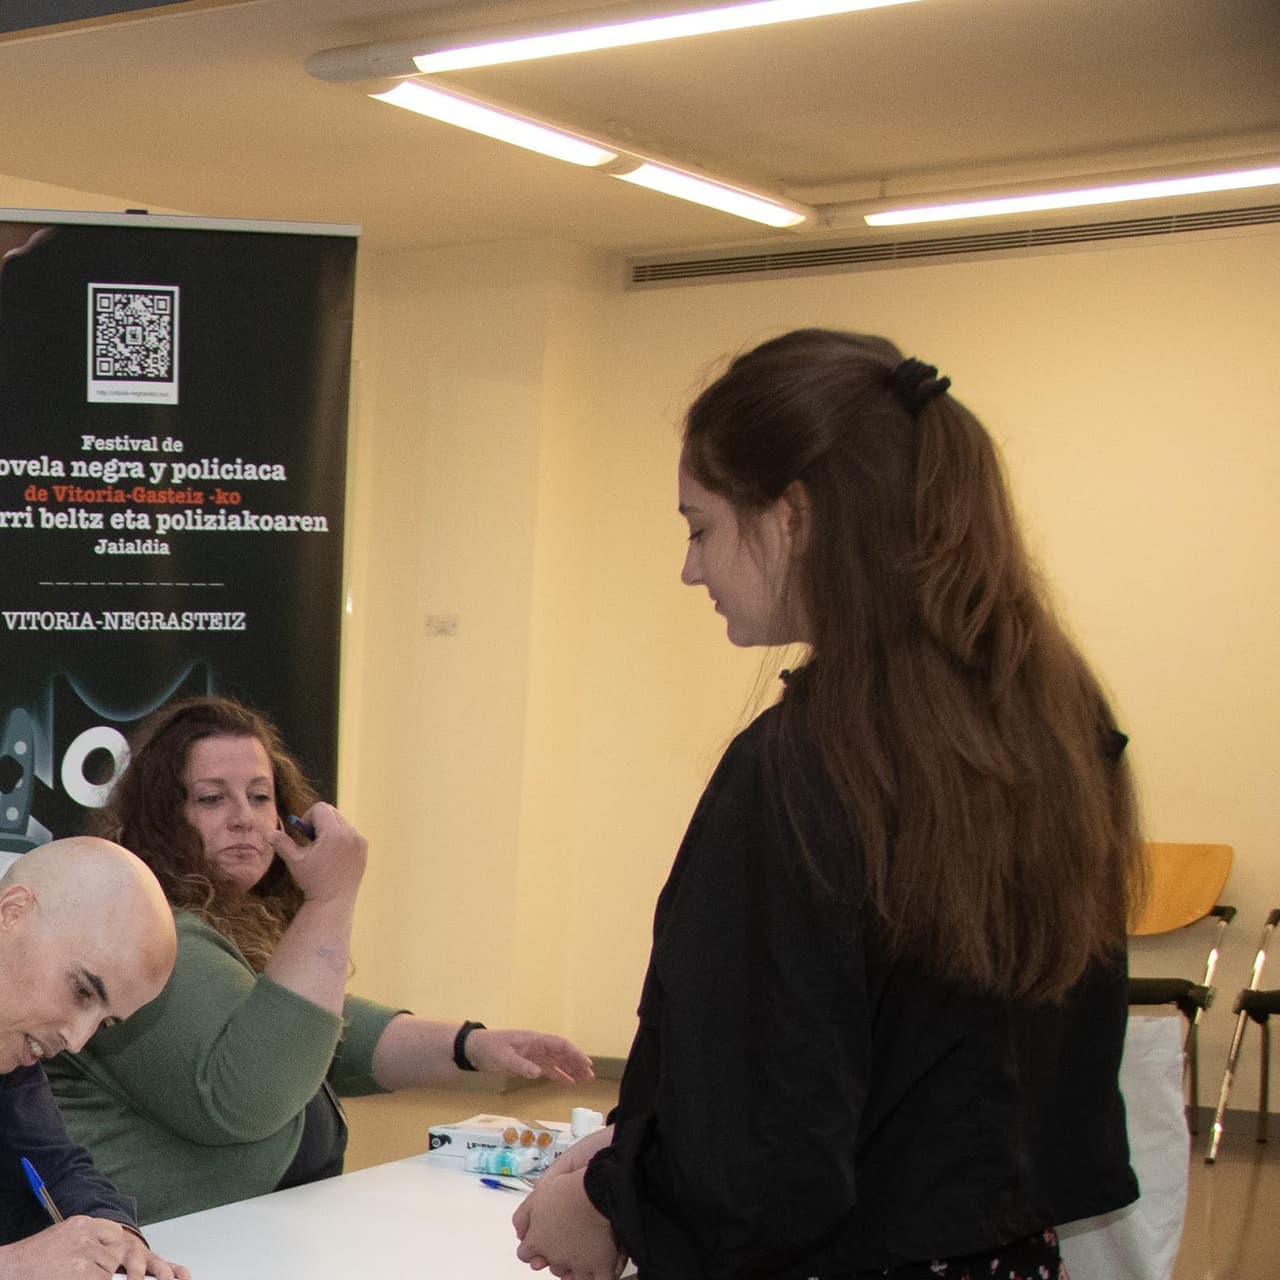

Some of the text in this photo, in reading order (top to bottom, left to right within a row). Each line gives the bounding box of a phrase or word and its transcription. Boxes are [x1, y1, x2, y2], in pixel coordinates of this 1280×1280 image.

[80, 434, 184, 453] Festival de
[70, 457, 146, 483] negra
[148, 462, 167, 485] y
[170, 457, 287, 484] policiaca
[24, 484, 242, 505] de Vitoria-Gasteiz -ko
[38, 506, 104, 531] beltz
[109, 508, 152, 531] eta
[155, 508, 330, 535] poliziakoaren
[93, 537, 171, 555] Jaialdia
[1, 610, 247, 632] VITORIA-NEGRASTEIZ
